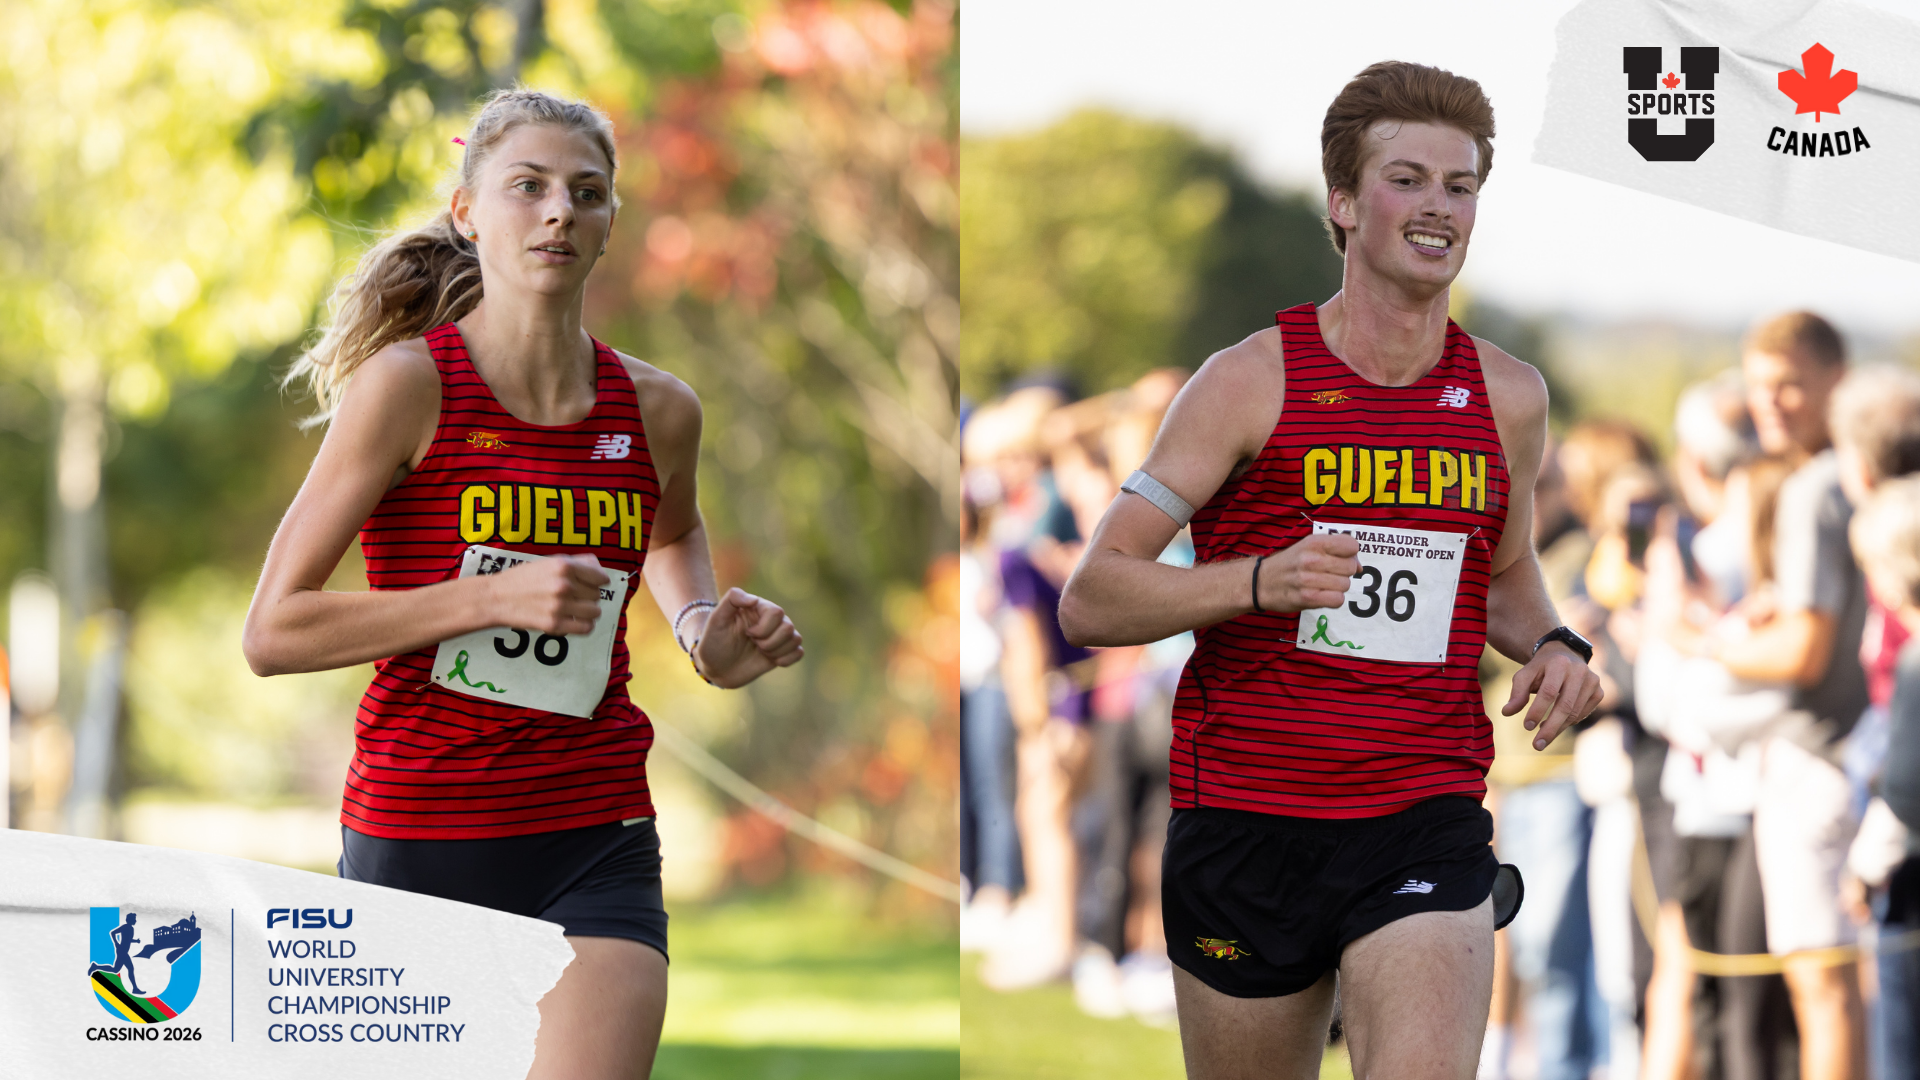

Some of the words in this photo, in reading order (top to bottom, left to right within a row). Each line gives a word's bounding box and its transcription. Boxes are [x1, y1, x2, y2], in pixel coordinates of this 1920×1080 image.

[1303, 446, 1487, 512] GUELPH
[458, 483, 643, 552] GUELPH
[1355, 531, 1429, 547] MARAUDER
[1425, 549, 1456, 560] OPEN
[1348, 565, 1418, 623] 36
